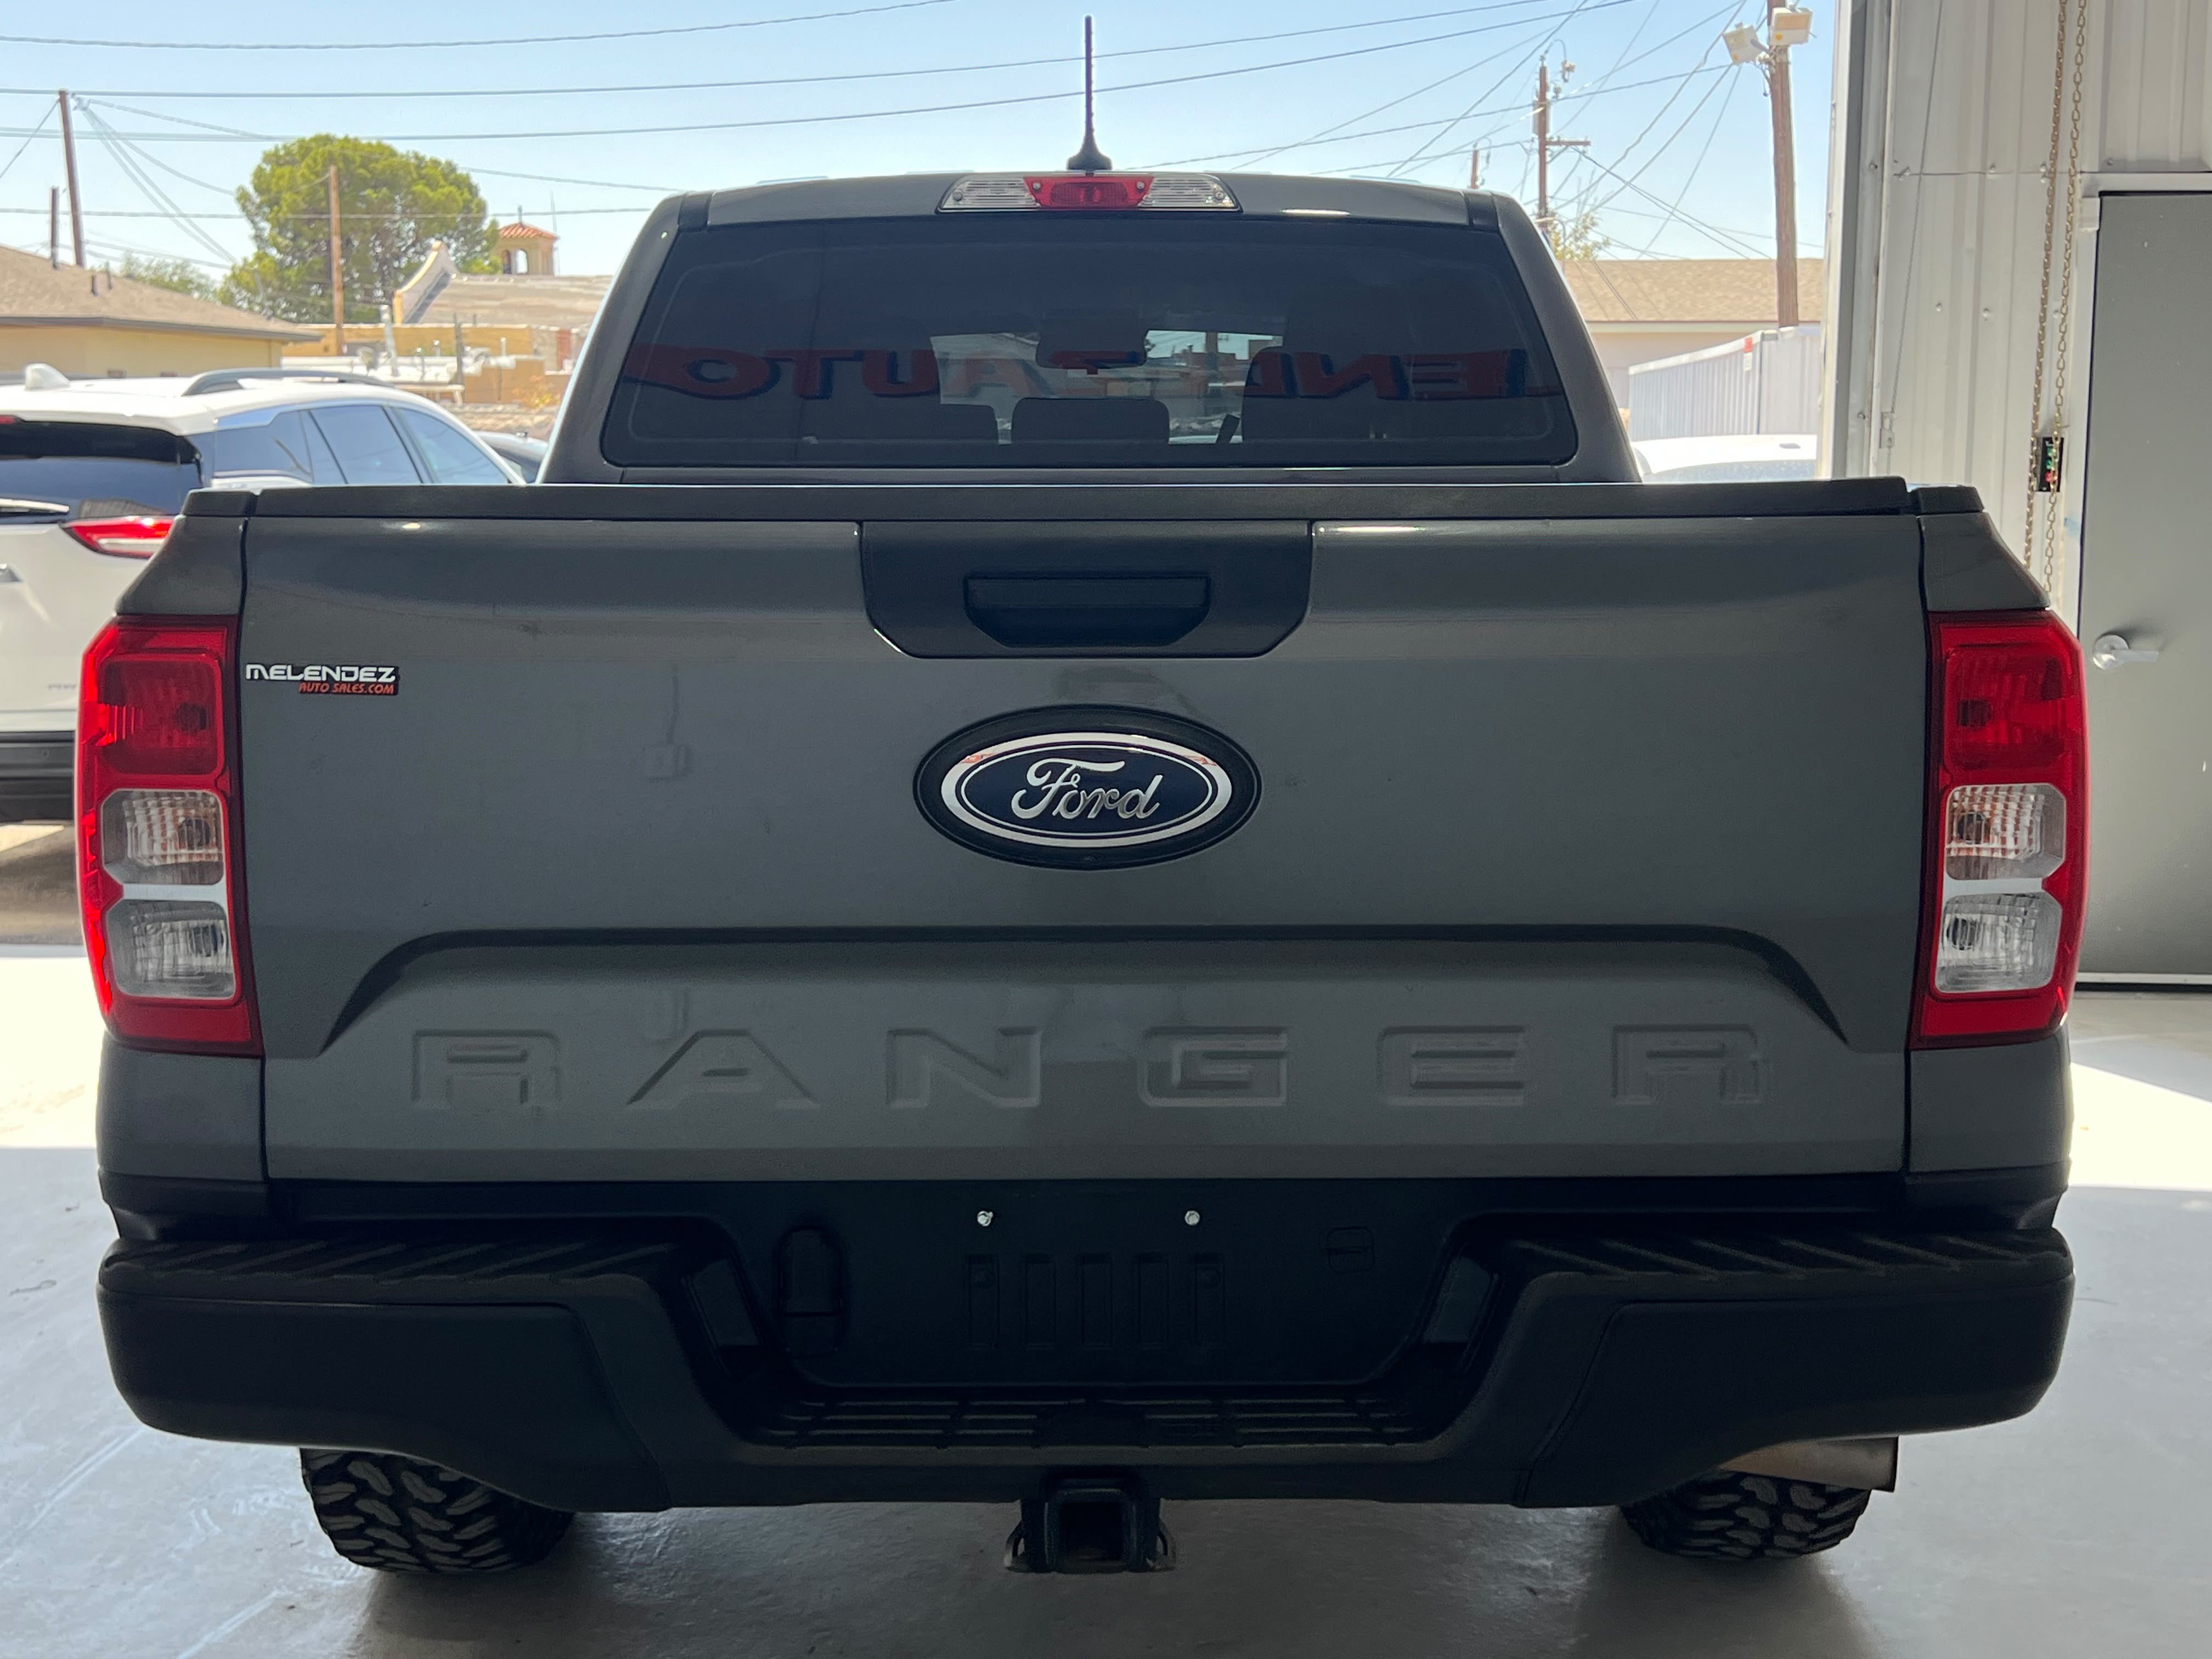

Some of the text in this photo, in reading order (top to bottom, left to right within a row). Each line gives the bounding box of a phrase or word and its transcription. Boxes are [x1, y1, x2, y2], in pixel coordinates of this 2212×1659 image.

[246, 663, 396, 682] MELENDEZ
[298, 682, 396, 695] AUTO SALES.COM
[1011, 757, 1164, 819] Ford
[411, 1023, 1761, 1108] RANGER
